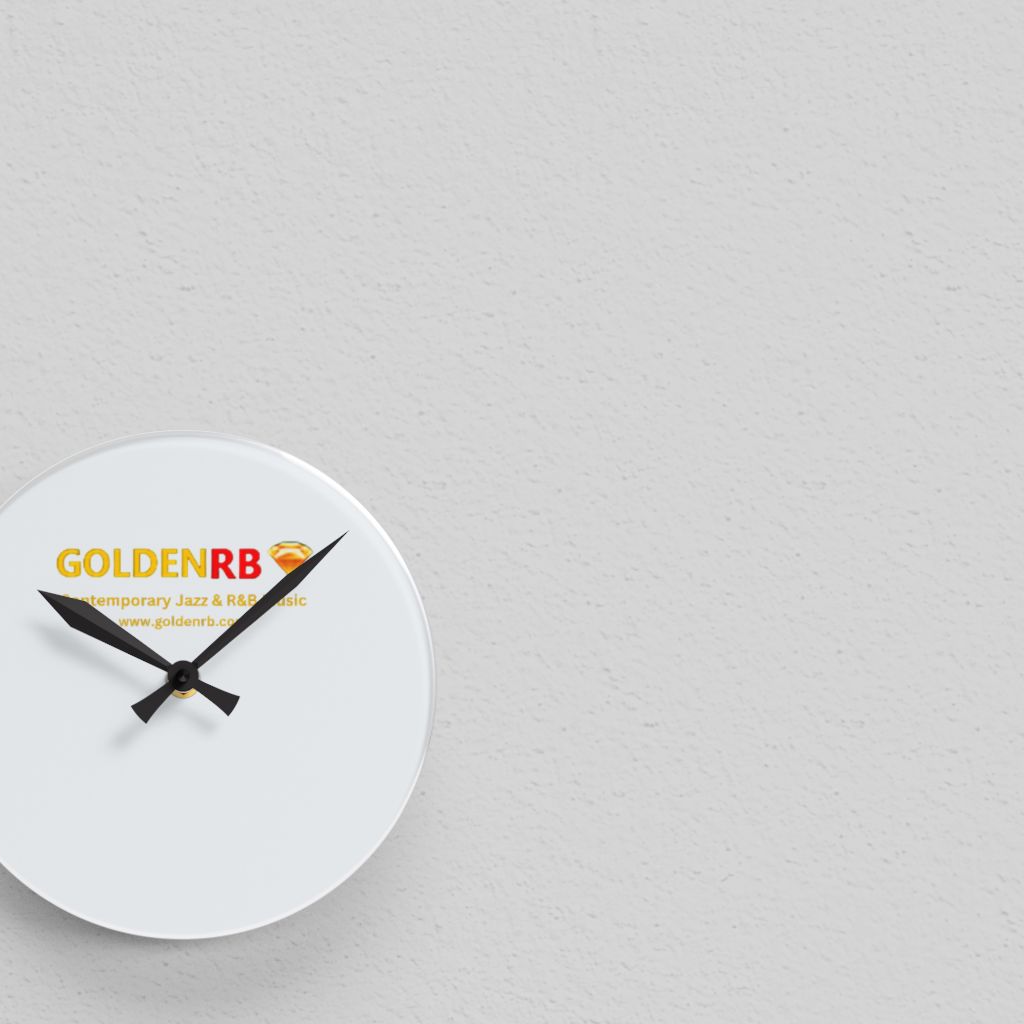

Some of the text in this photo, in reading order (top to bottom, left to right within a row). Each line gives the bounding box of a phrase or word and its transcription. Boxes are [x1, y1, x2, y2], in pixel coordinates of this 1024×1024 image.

[56, 548, 262, 579] GOLDENRB
[176, 594, 209, 607] Jazz
[211, 593, 223, 607] &
[226, 593, 257, 607] R&B
[268, 594, 307, 607] usic
[118, 615, 237, 630] www.goldenrb.co
